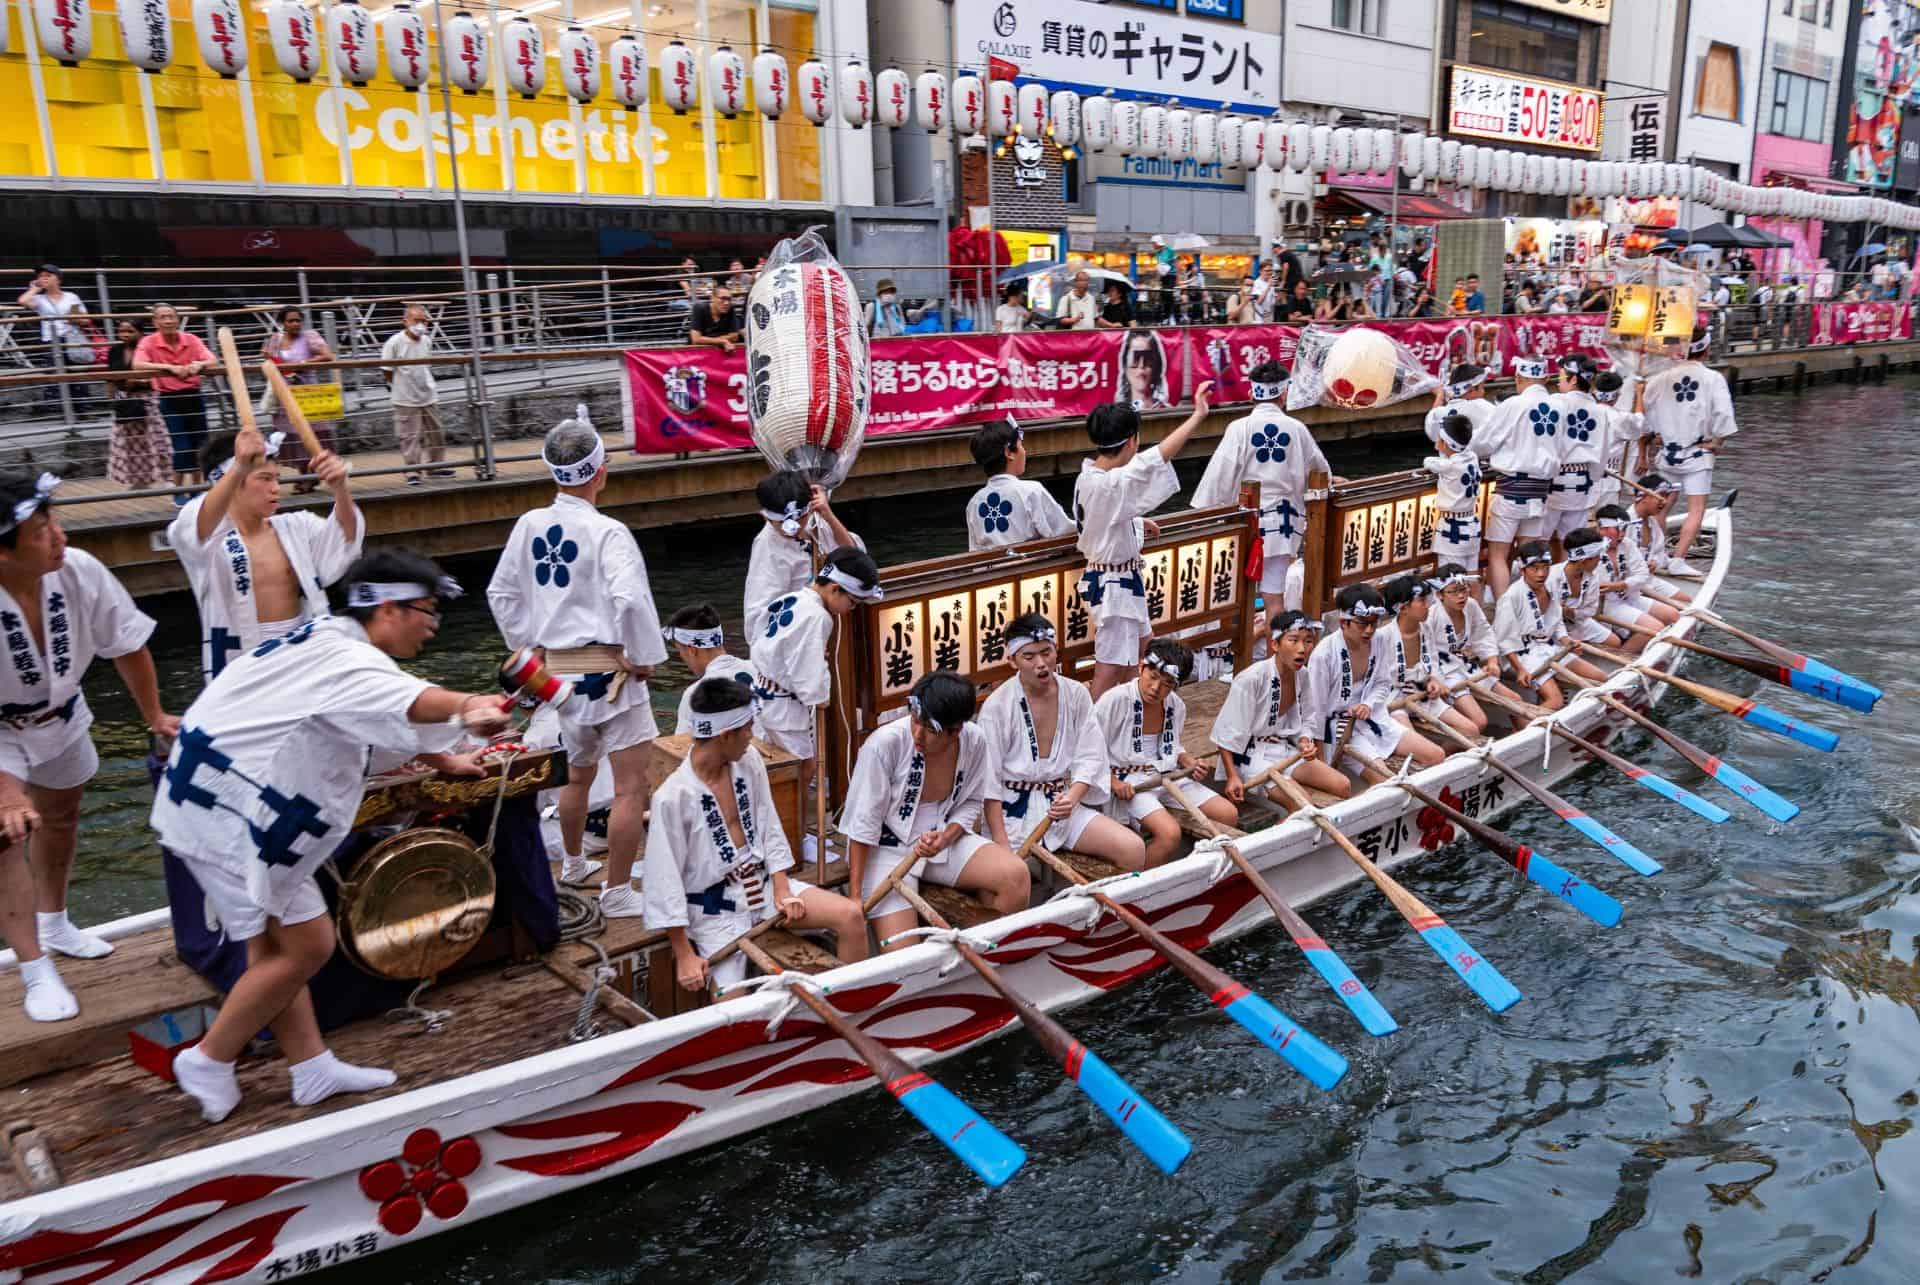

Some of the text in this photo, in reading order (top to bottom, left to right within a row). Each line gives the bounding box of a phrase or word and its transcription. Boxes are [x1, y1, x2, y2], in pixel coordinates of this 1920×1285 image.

[1041, 20, 1264, 90] 賃貸のギャラント
[315, 87, 670, 165] Cosmetic
[1631, 103, 1660, 161] 伝串
[1343, 522, 1359, 570] 小若
[1369, 517, 1384, 565] 小若
[1393, 512, 1409, 558] 小若
[1418, 507, 1434, 551] 小若
[1145, 566, 1164, 620] 小若
[1179, 558, 1199, 611] 小若
[1213, 550, 1232, 602] 小若
[1028, 591, 1048, 615] 小
[1067, 583, 1088, 640] 小若
[885, 623, 914, 690] 小若
[934, 612, 960, 672] 小若
[980, 602, 1006, 663] 小若
[266, 1232, 379, 1281] 木場小若
